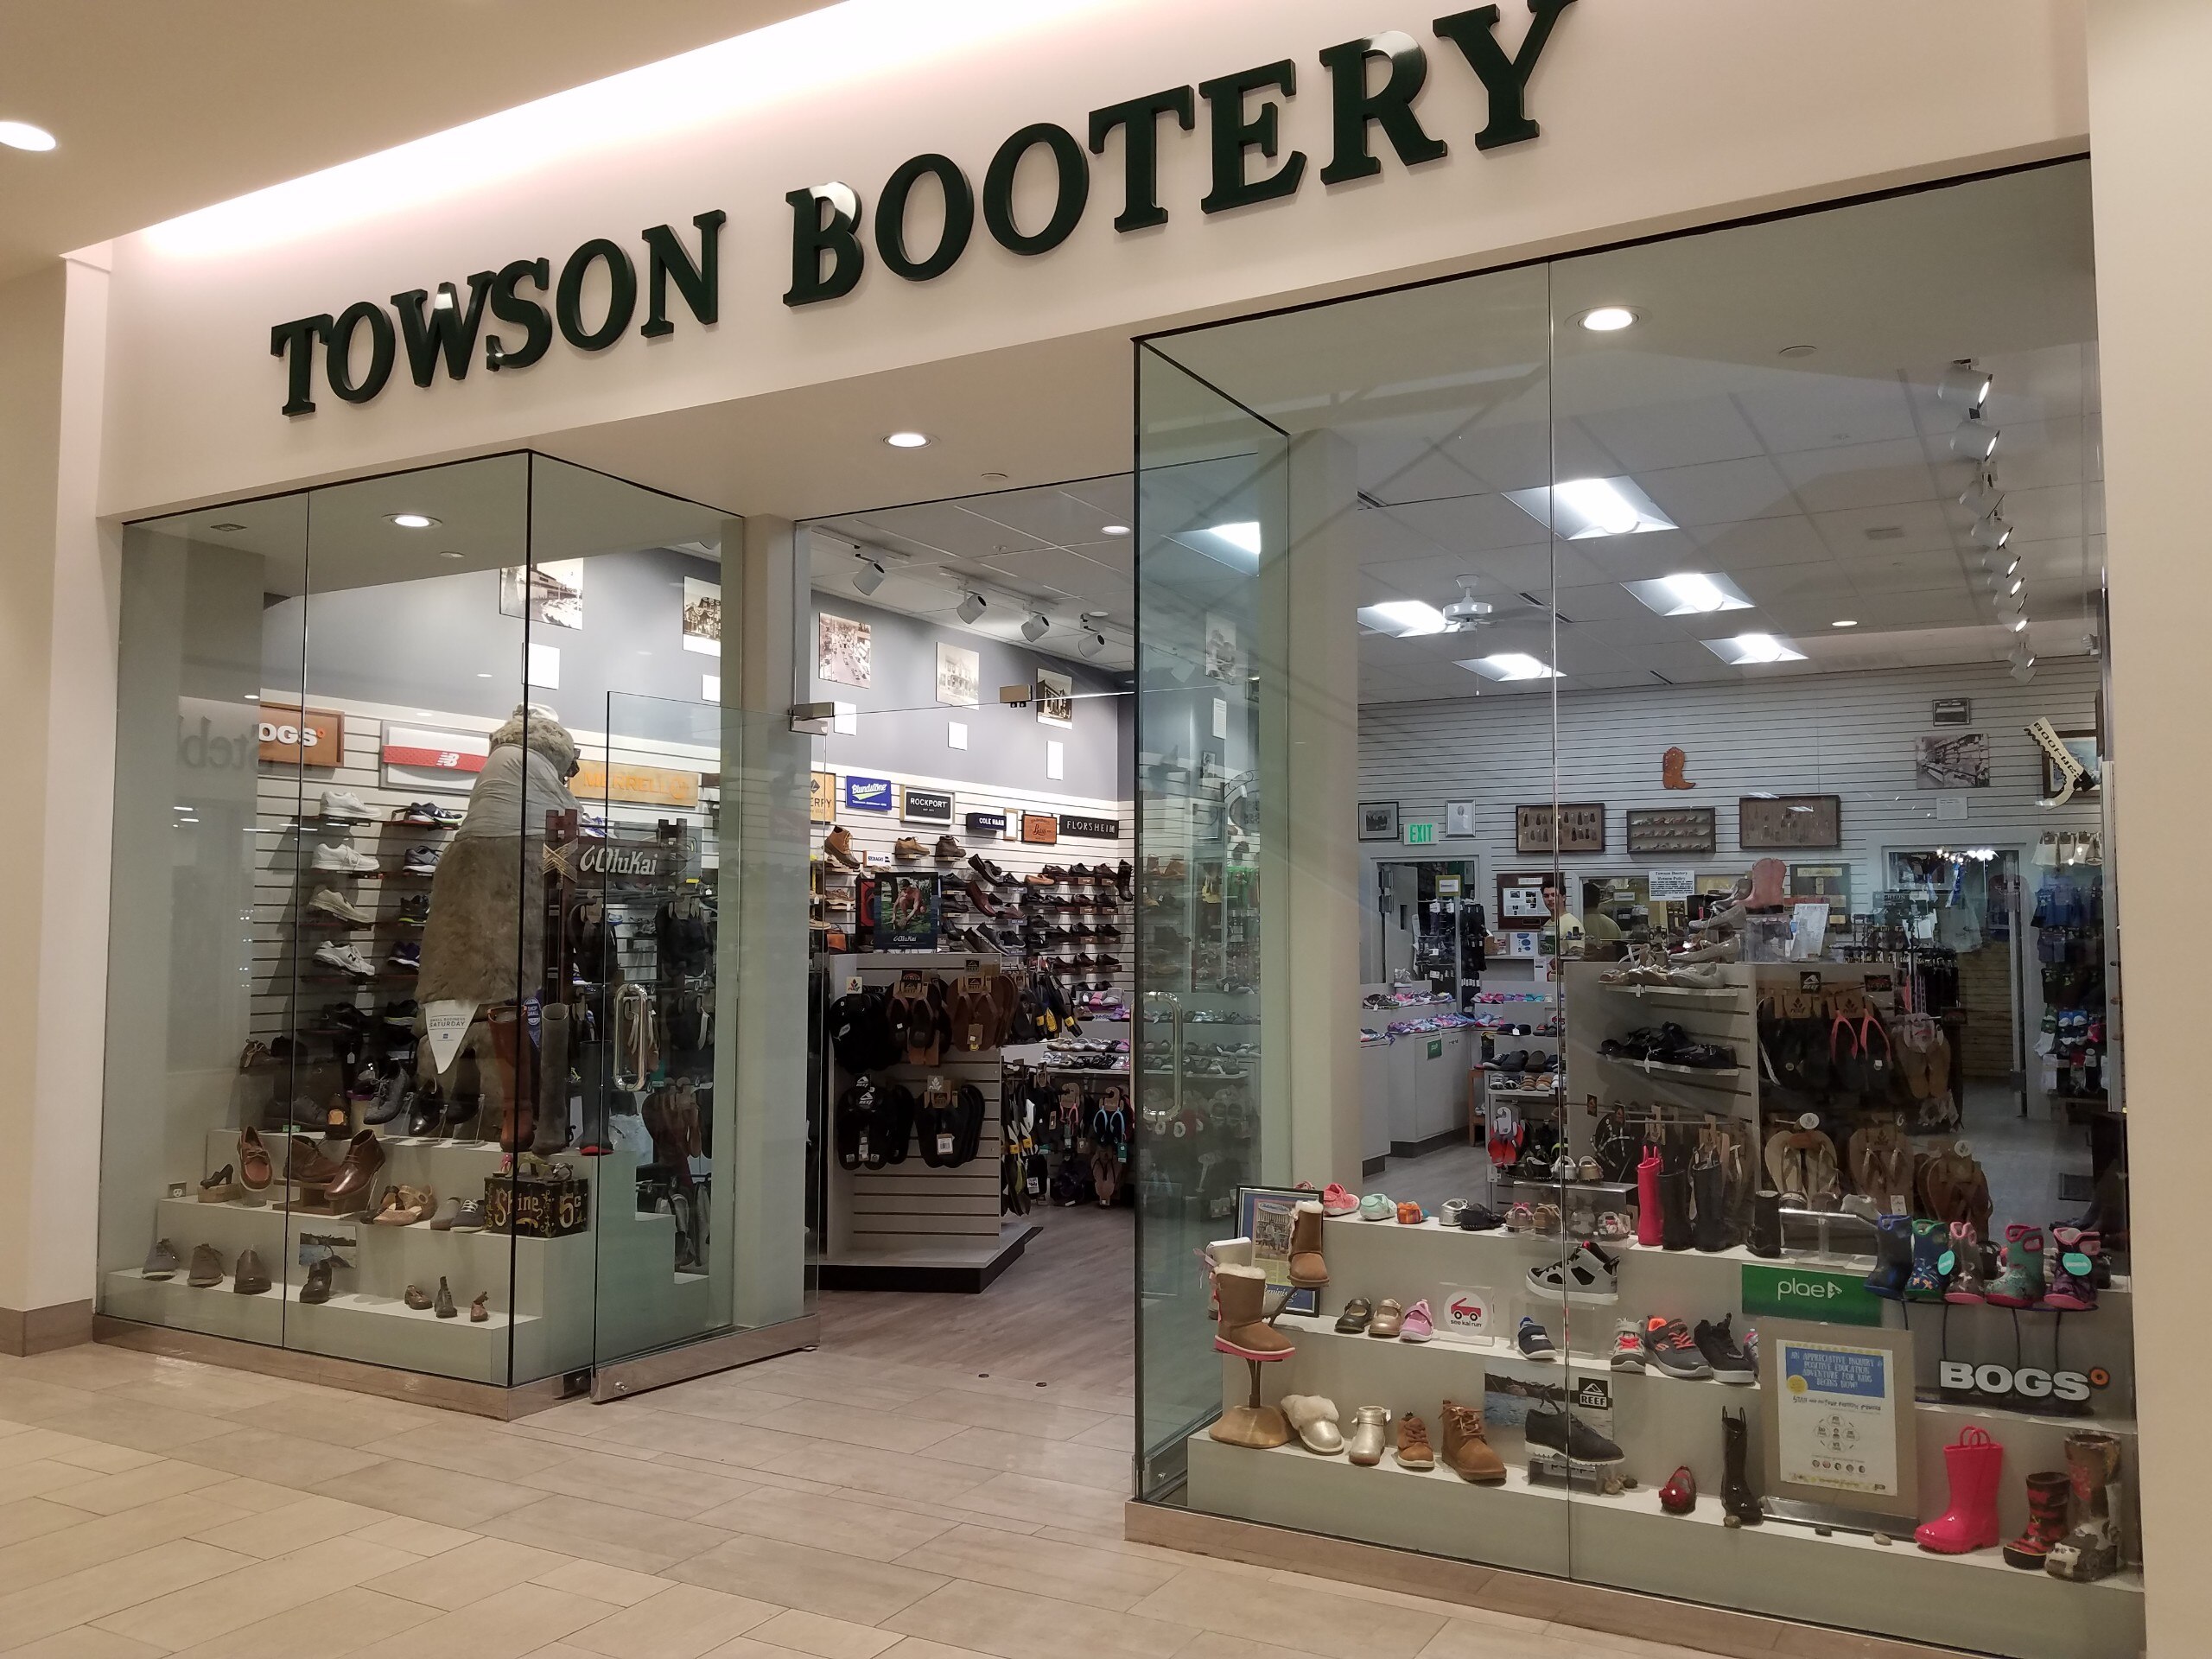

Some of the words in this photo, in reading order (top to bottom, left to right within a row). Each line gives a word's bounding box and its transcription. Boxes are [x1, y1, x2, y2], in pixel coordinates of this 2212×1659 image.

[270, 210, 726, 416] TOWSON
[783, 0, 1578, 307] BOOTERY
[851, 783, 888, 794] Blundstone
[910, 798, 947, 808] ROCKPORT
[1066, 821, 1116, 834] FLORSHEIM
[1409, 824, 1433, 843] EXIT
[595, 848, 658, 875] OluKai
[1777, 1277, 1825, 1301] plae
[1803, 1352, 1846, 1364] APPRECIATIVE
[1849, 1356, 1874, 1367] INQUIRY
[1802, 1369, 1839, 1379] ADVENTURE
[1842, 1372, 1855, 1381] FOR
[1804, 1361, 1831, 1370] POSITIVE
[1834, 1364, 1870, 1375] EDUCATION
[1939, 1360, 2091, 1402] BOGS
[1580, 1395, 1606, 1407] REEF
